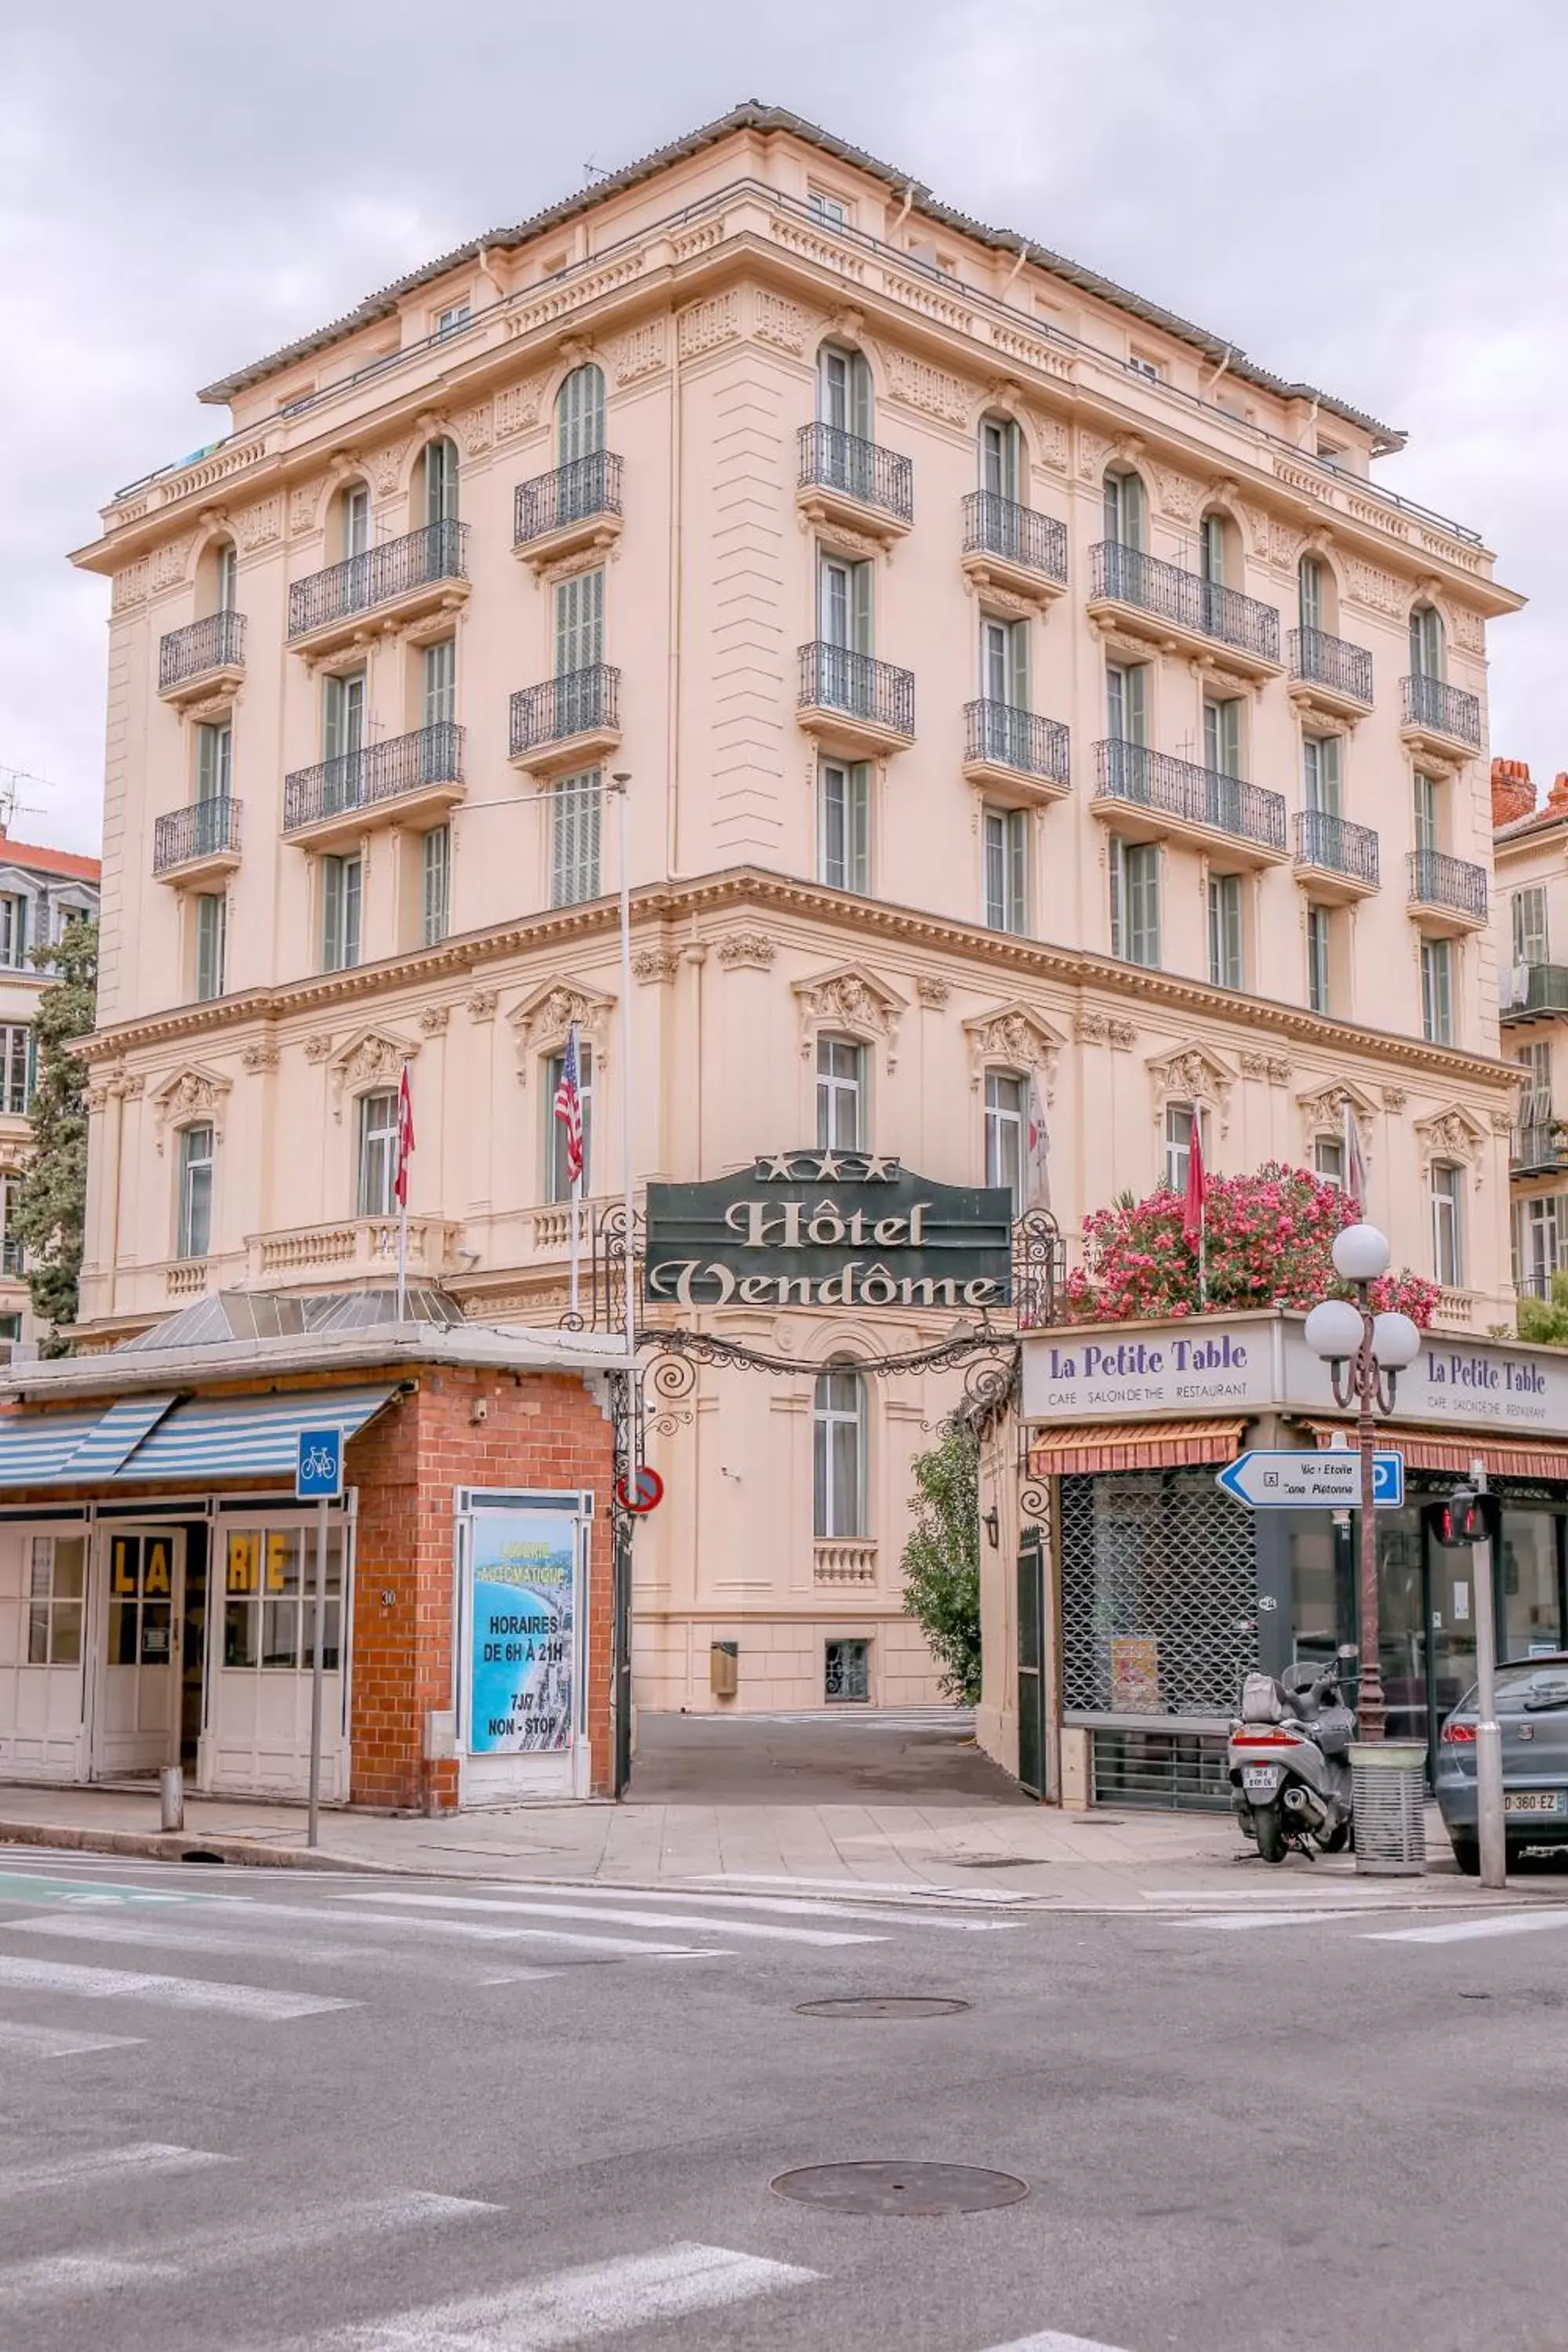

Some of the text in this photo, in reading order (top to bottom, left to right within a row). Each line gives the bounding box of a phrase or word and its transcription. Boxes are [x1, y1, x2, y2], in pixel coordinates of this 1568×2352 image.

[725, 1198, 934, 1247] Hôtel
[650, 1260, 1000, 1308] Vendôme
[1049, 1335, 1248, 1379] La Petite Table
[1428, 1351, 1547, 1395] La Petite Table
[1087, 1389, 1125, 1404] SALON
[1176, 1382, 1247, 1399] RESTAURANT
[489, 1616, 558, 1635] HORAIRES
[483, 1638, 563, 1662] DE 6H À 21H
[488, 1718, 515, 1736] NON
[524, 1717, 556, 1735] STOP
